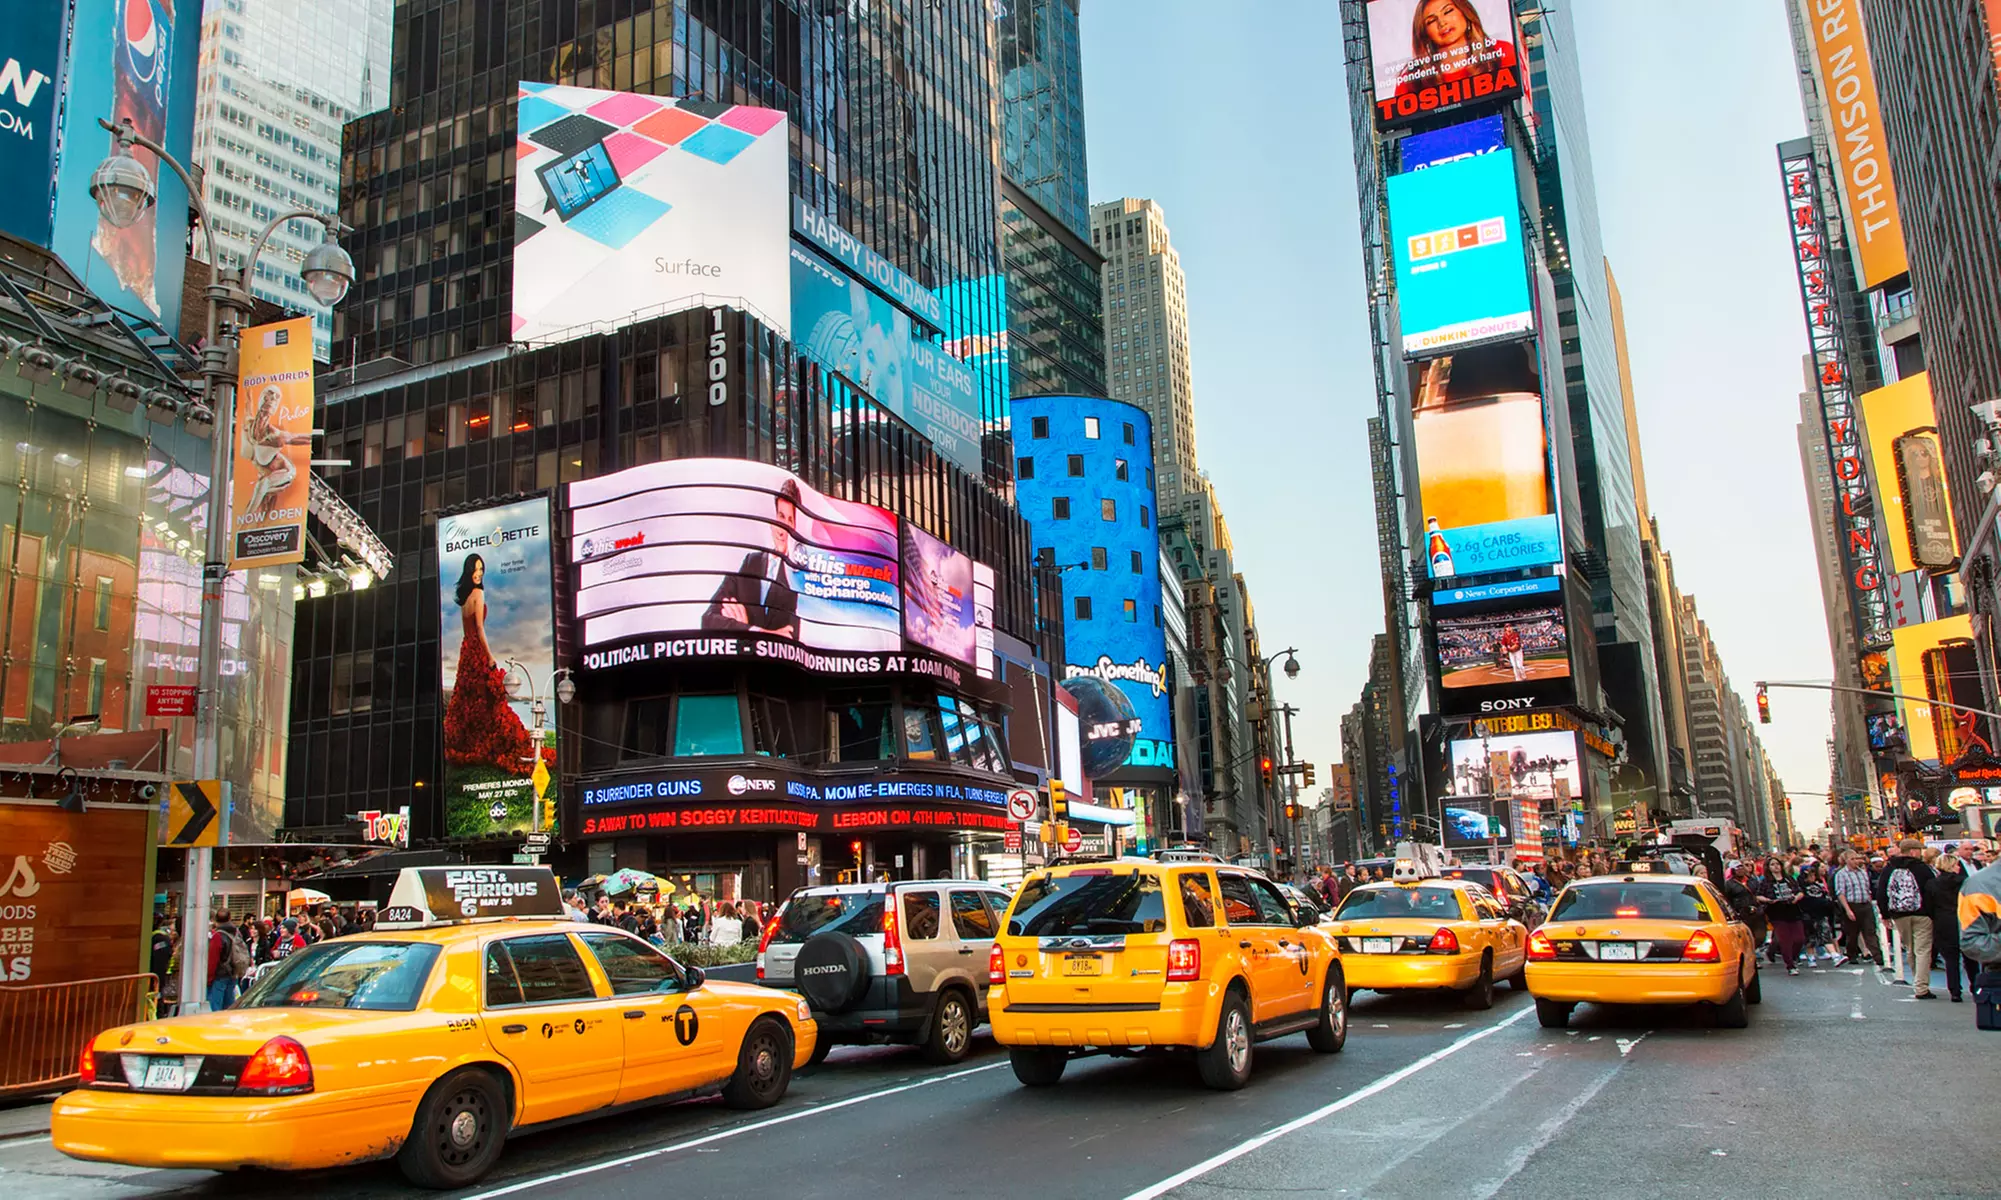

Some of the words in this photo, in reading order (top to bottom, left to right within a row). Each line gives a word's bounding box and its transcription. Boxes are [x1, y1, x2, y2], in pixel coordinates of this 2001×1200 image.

[1384, 62, 1405, 75] ever
[1406, 56, 1431, 71] gave
[1433, 50, 1448, 61] me
[1449, 45, 1470, 57] was
[1471, 42, 1483, 51] to
[1484, 37, 1497, 47] be
[1440, 63, 1451, 73] to
[1452, 54, 1478, 68] work
[1479, 48, 1506, 62] hard,
[0, 57, 44, 108] N
[1377, 68, 1517, 120] TOSHIBA
[1828, 45, 1891, 243] THOMSON
[1790, 173, 1829, 326] ERNST
[654, 257, 722, 279] Surface
[790, 249, 846, 288] NITTO
[802, 204, 861, 266] HAPPY
[865, 249, 941, 321] HOLIDAYS
[1471, 320, 1518, 336] DONUTS
[709, 309, 727, 407] 1500
[243, 376, 266, 388] BODY
[270, 369, 310, 382] WORLDS
[938, 358, 972, 397] EARS
[930, 378, 952, 400] YOUR
[279, 405, 310, 426] Pulse
[912, 387, 979, 441] NDERDOG
[926, 423, 958, 453] STORY
[236, 511, 266, 525] NOW
[269, 507, 303, 521] OPEN
[247, 532, 289, 544] Discovery
[446, 526, 540, 553] BACHELORETTE
[1455, 541, 1480, 553] 2.6g
[1482, 532, 1521, 549] CARBS
[1470, 552, 1485, 564] 95
[1487, 541, 1545, 561] CALORIES
[808, 553, 845, 575] this
[845, 563, 892, 582] week
[821, 573, 871, 590] George
[1465, 589, 1487, 599] News
[1489, 582, 1539, 595] Corporation
[804, 582, 893, 605] Stephanopoulos
[654, 639, 738, 658] PICTURE
[886, 656, 907, 672] AT
[912, 658, 942, 677] 10AM
[1065, 664, 1100, 679] raw
[150, 688, 160, 696] NO
[161, 688, 192, 697] STOPPING
[156, 697, 185, 705] ANYTIME
[1480, 696, 1535, 712] SONY
[1915, 707, 1932, 719] TH
[1088, 722, 1119, 739] JVC
[462, 780, 501, 792] PREMIERES
[502, 778, 534, 789] MONDAY
[584, 791, 594, 804] R
[596, 783, 653, 804] SURRENDER
[657, 780, 702, 796] GUNS
[747, 779, 776, 791] NEWS
[806, 786, 821, 800] PA.
[825, 786, 856, 800] MOM
[858, 782, 933, 798] RE-EMERGES
[936, 782, 944, 796] IN
[946, 784, 964, 801] FLA,
[964, 787, 984, 801] TURNS
[478, 791, 493, 800] MAY
[597, 815, 628, 832] AWAY
[629, 813, 646, 829] TO
[648, 811, 676, 828] WIN
[680, 809, 736, 826] SOGGY
[740, 809, 798, 826] KENTUCKY
[833, 810, 888, 828] LEBRON
[891, 810, 910, 825] ON
[912, 810, 933, 825] 4TH
[44, 853, 72, 870] BAKED
[48, 845, 75, 863] FRESH
[445, 870, 499, 888] FAST
[454, 882, 537, 902] FURIOUS
[0, 904, 37, 920] ODS
[388, 908, 412, 921] 8A24
[461, 898, 478, 917] 6
[480, 898, 500, 907] MAY
[501, 897, 513, 906] 24
[1, 926, 34, 942] EE
[0, 943, 33, 956] ATE
[803, 964, 847, 976] HONDA
[661, 1014, 673, 1023] NYC
